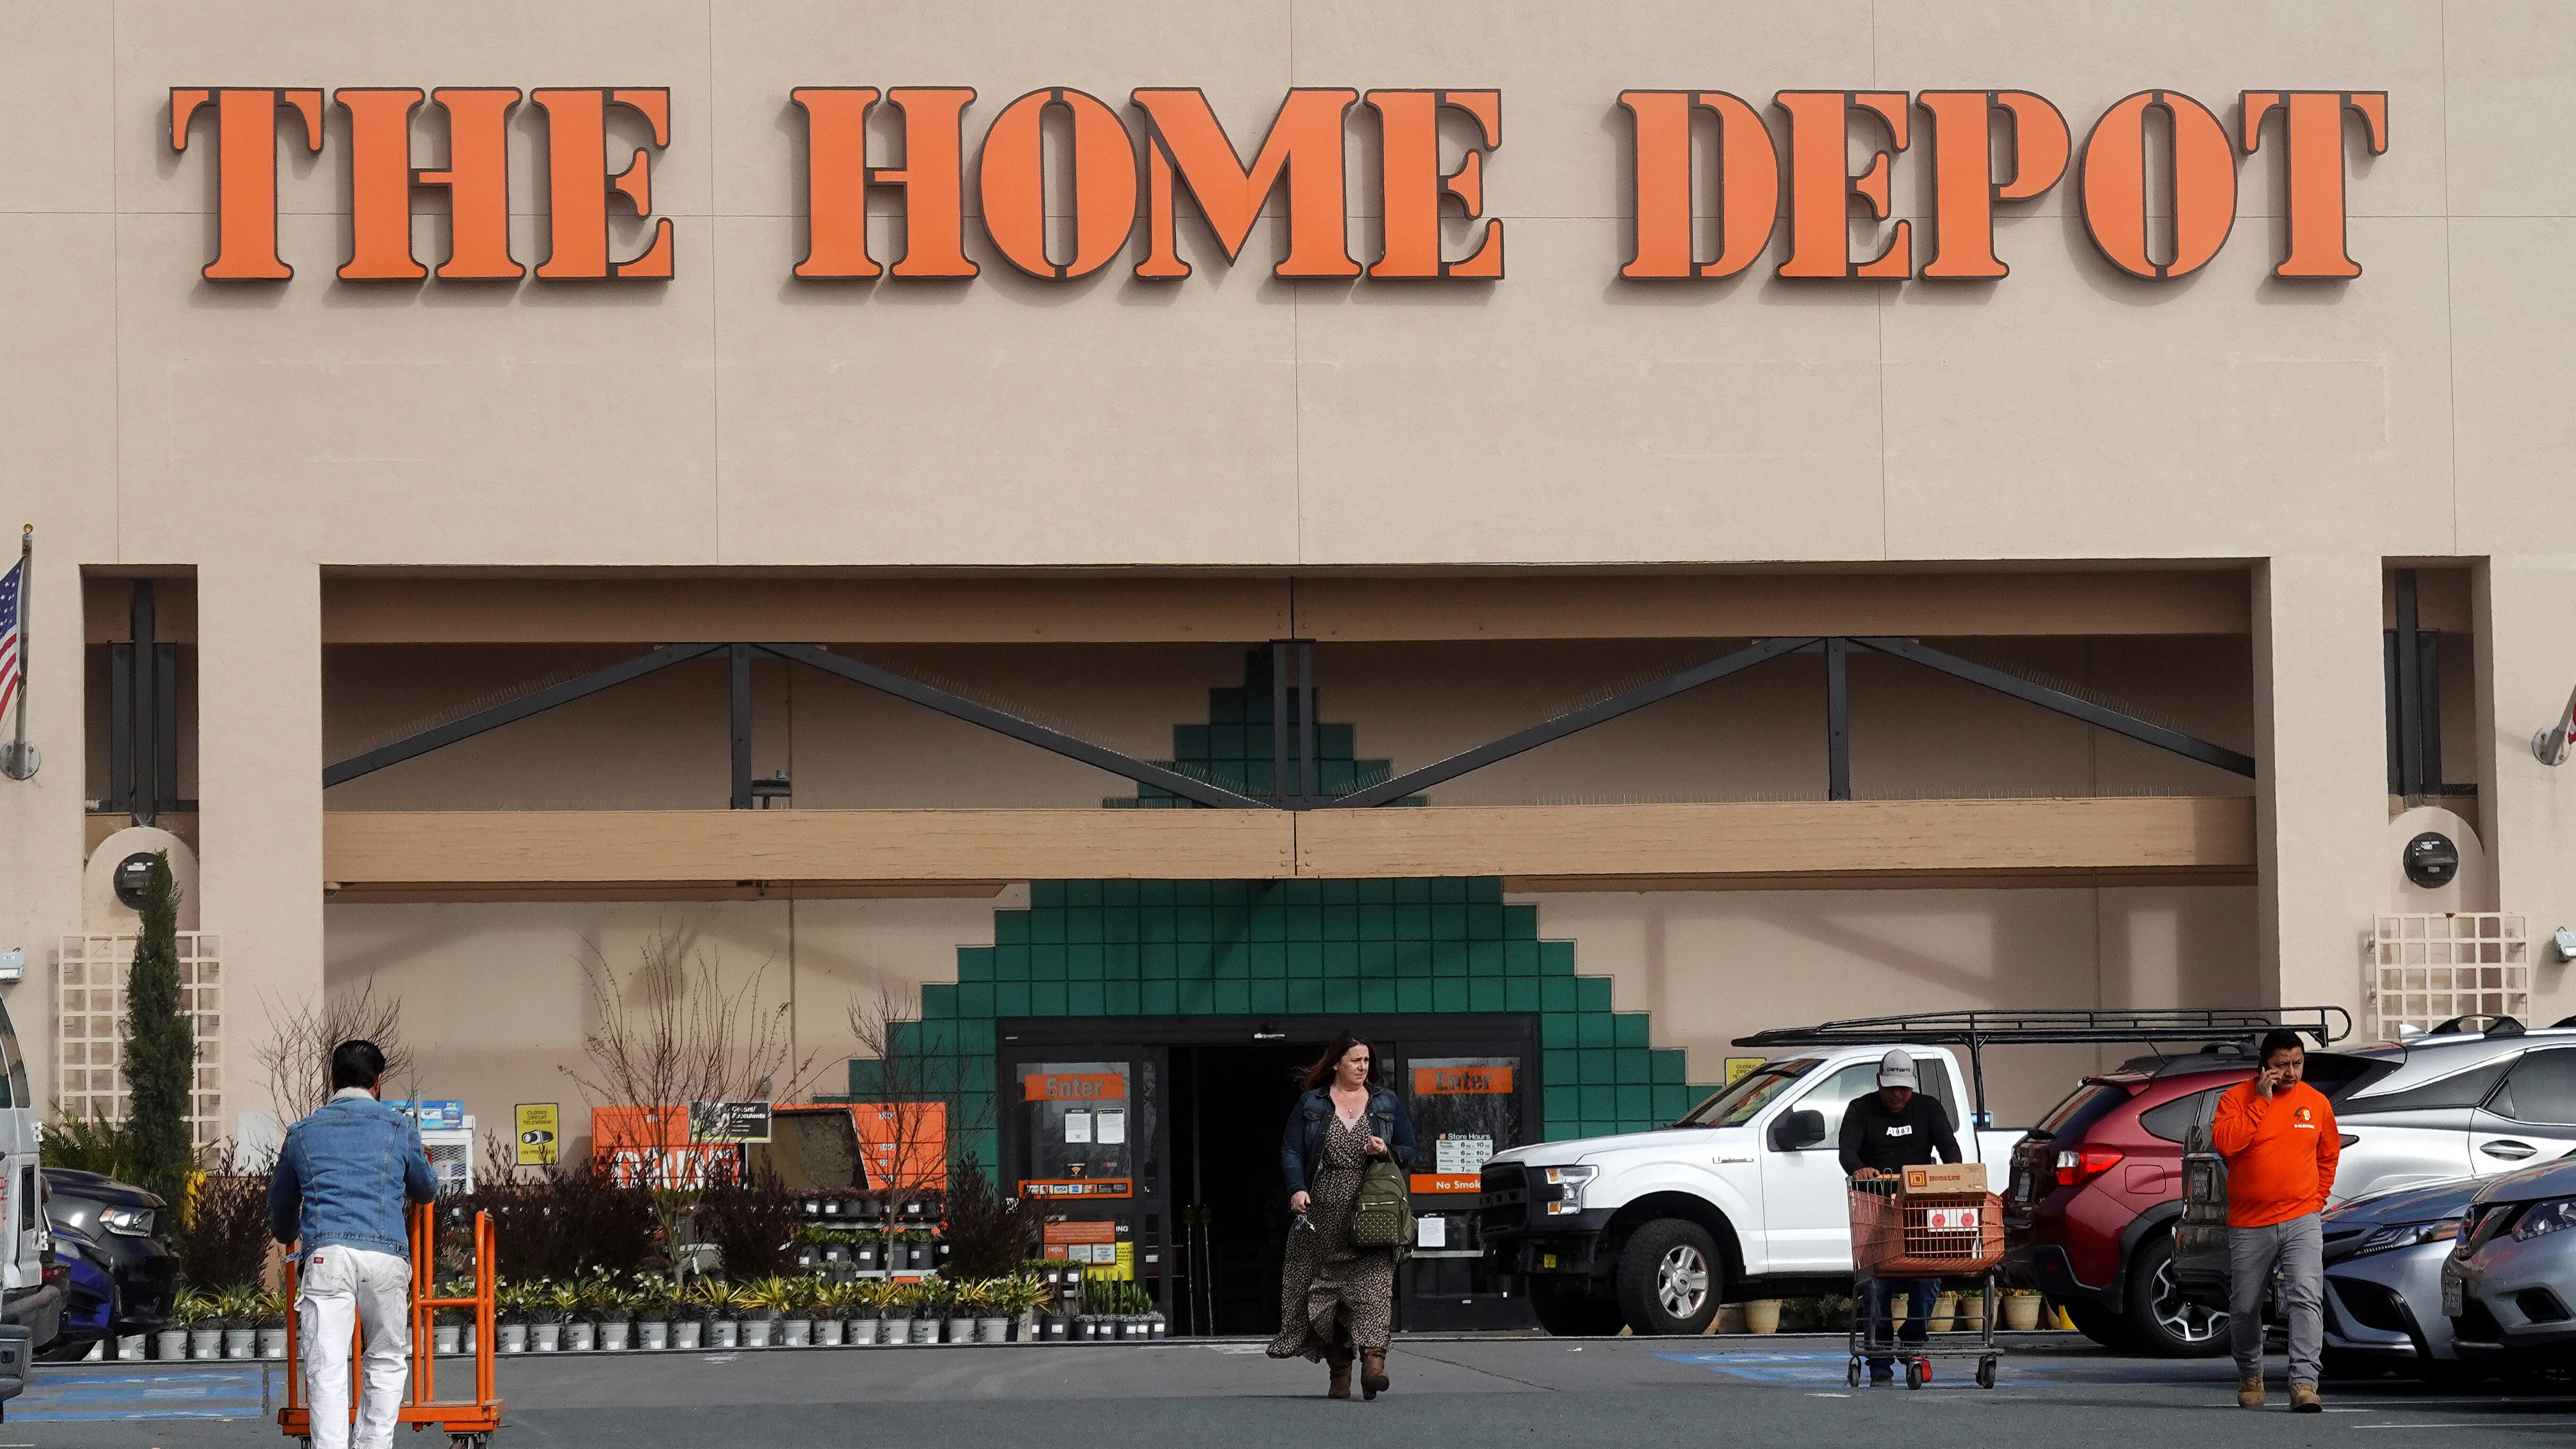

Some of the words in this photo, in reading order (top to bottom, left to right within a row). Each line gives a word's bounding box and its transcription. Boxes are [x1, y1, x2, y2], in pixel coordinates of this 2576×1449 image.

[170, 87, 674, 282] THE
[791, 86, 1505, 282] HOME
[1617, 89, 2388, 282] DEPOT
[1046, 1078, 1104, 1097] Enter
[1436, 1071, 1492, 1090] Enter
[1454, 1180, 1481, 1189] Smok
